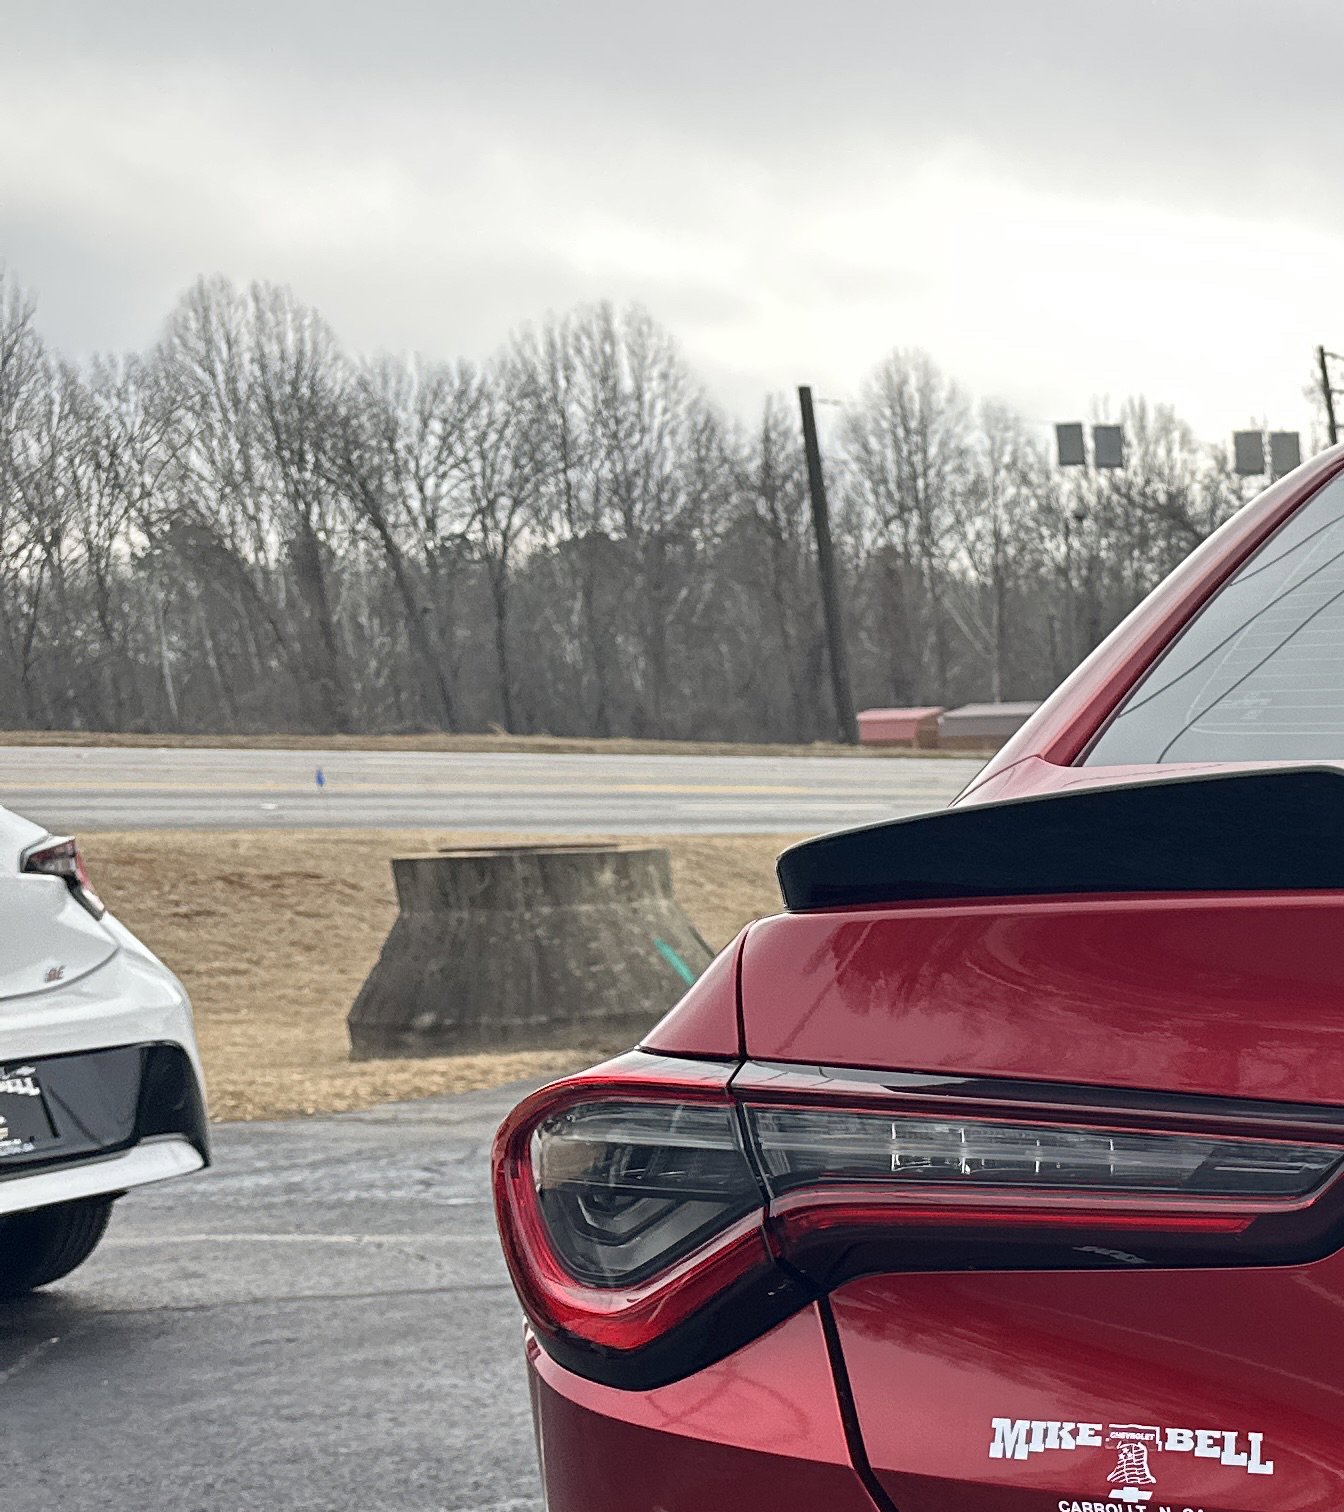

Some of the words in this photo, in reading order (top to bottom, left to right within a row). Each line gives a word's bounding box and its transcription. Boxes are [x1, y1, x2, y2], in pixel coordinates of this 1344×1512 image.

[989, 1417, 1103, 1460] MIKE
[1164, 1427, 1274, 1475] BELL
[1109, 1431, 1156, 1441] CHEVROLET
